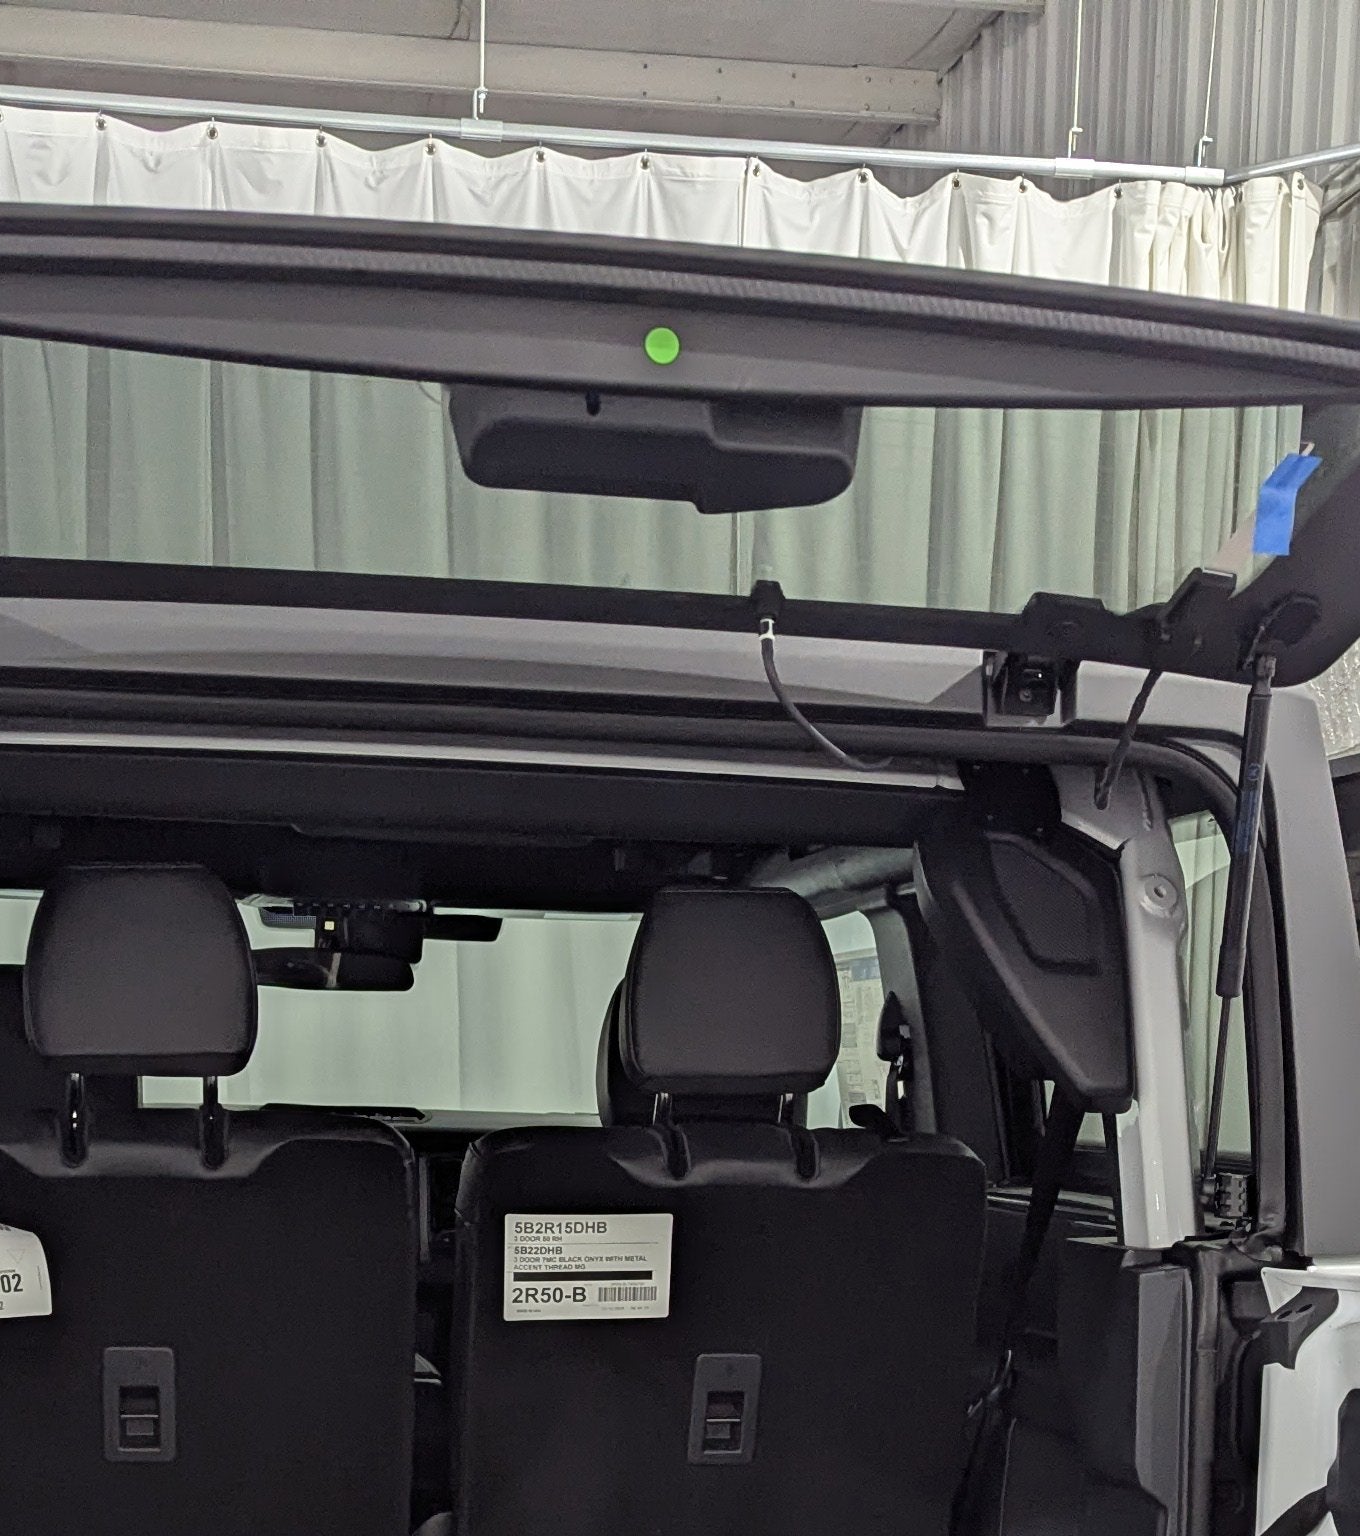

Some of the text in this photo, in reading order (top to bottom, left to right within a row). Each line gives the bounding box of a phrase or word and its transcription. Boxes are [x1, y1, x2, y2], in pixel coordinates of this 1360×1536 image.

[514, 1221, 608, 1234] 5B2R15DHB
[514, 1246, 563, 1255] 5B22DHB
[512, 1287, 587, 1304] 2R50-B
